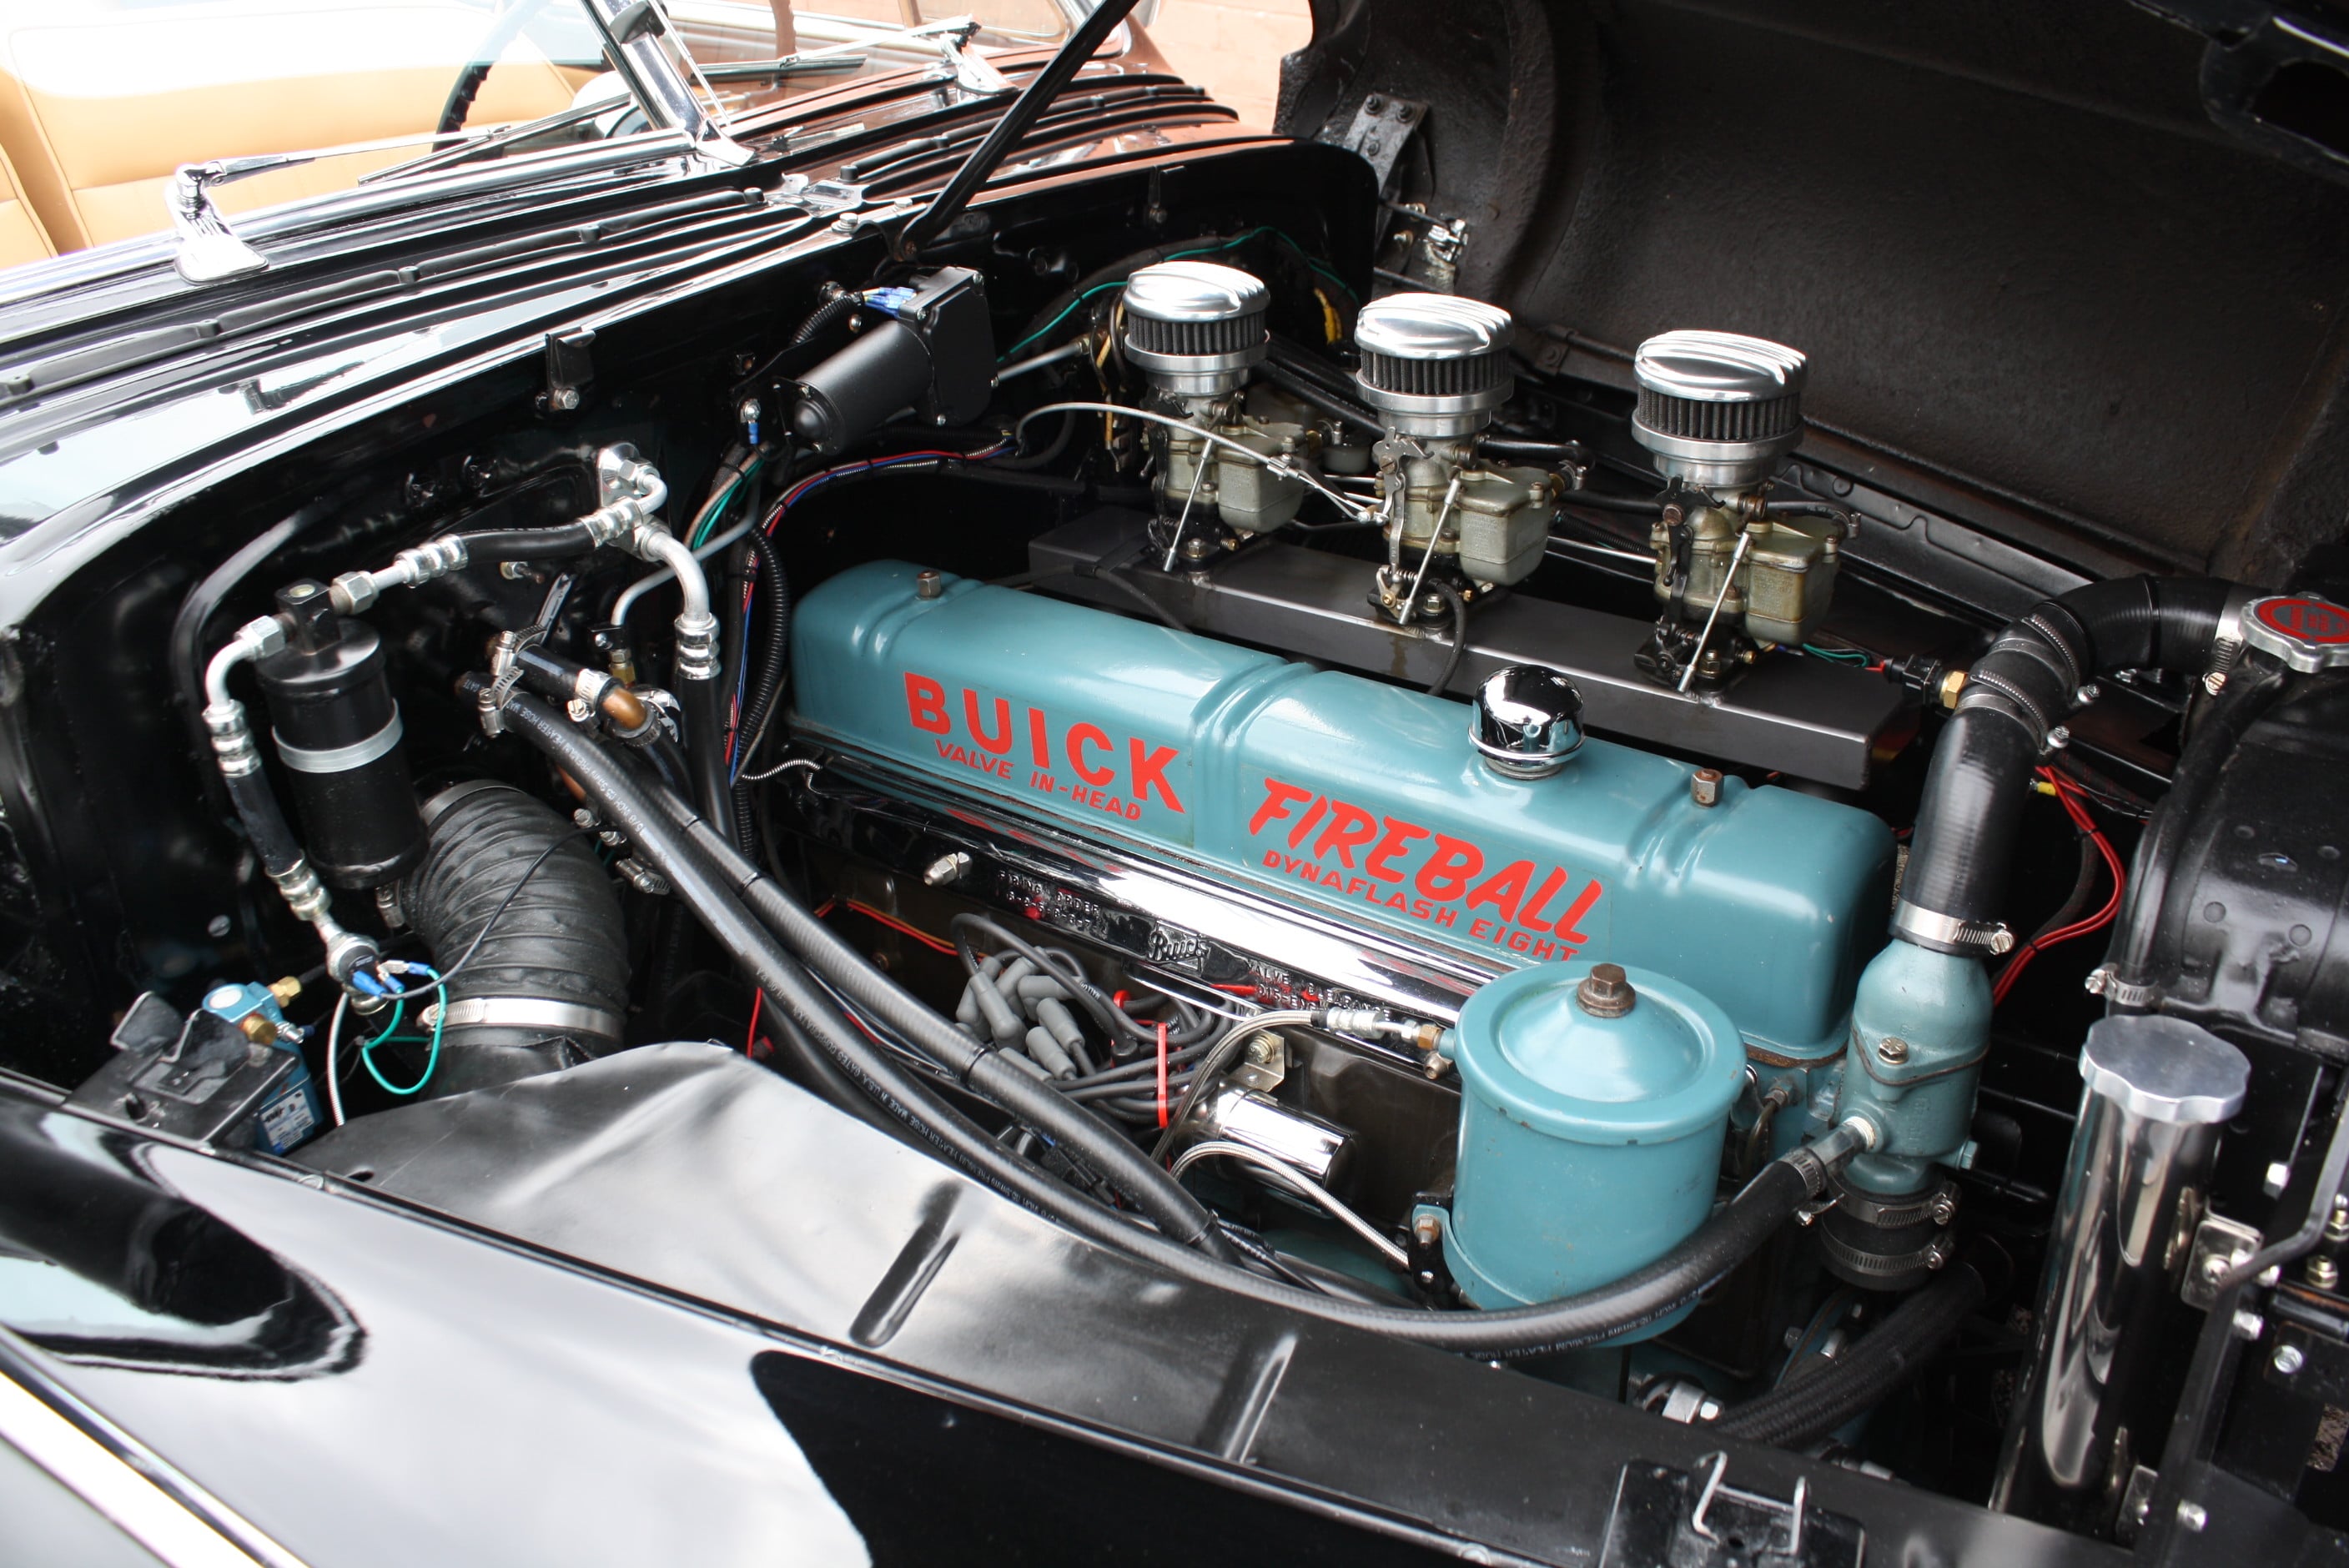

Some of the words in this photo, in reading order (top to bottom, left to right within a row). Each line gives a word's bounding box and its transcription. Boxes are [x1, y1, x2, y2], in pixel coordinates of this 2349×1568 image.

[520, 706, 540, 725] HOSE
[904, 672, 1185, 812] BUICK
[935, 739, 1014, 779] VALVE
[1029, 771, 1142, 821] IN-HEAD
[1249, 777, 1602, 943] FIREBALL
[1056, 892, 1100, 916] ORDER
[1262, 849, 1459, 927] DYNAFLASH
[1469, 918, 1580, 962] EIGHT
[1147, 930, 1210, 962] Buick
[1250, 960, 1290, 985] VALVE
[837, 1051, 862, 1077] GATES
[887, 1098, 909, 1120] MADE
[906, 1114, 932, 1137] HOSE
